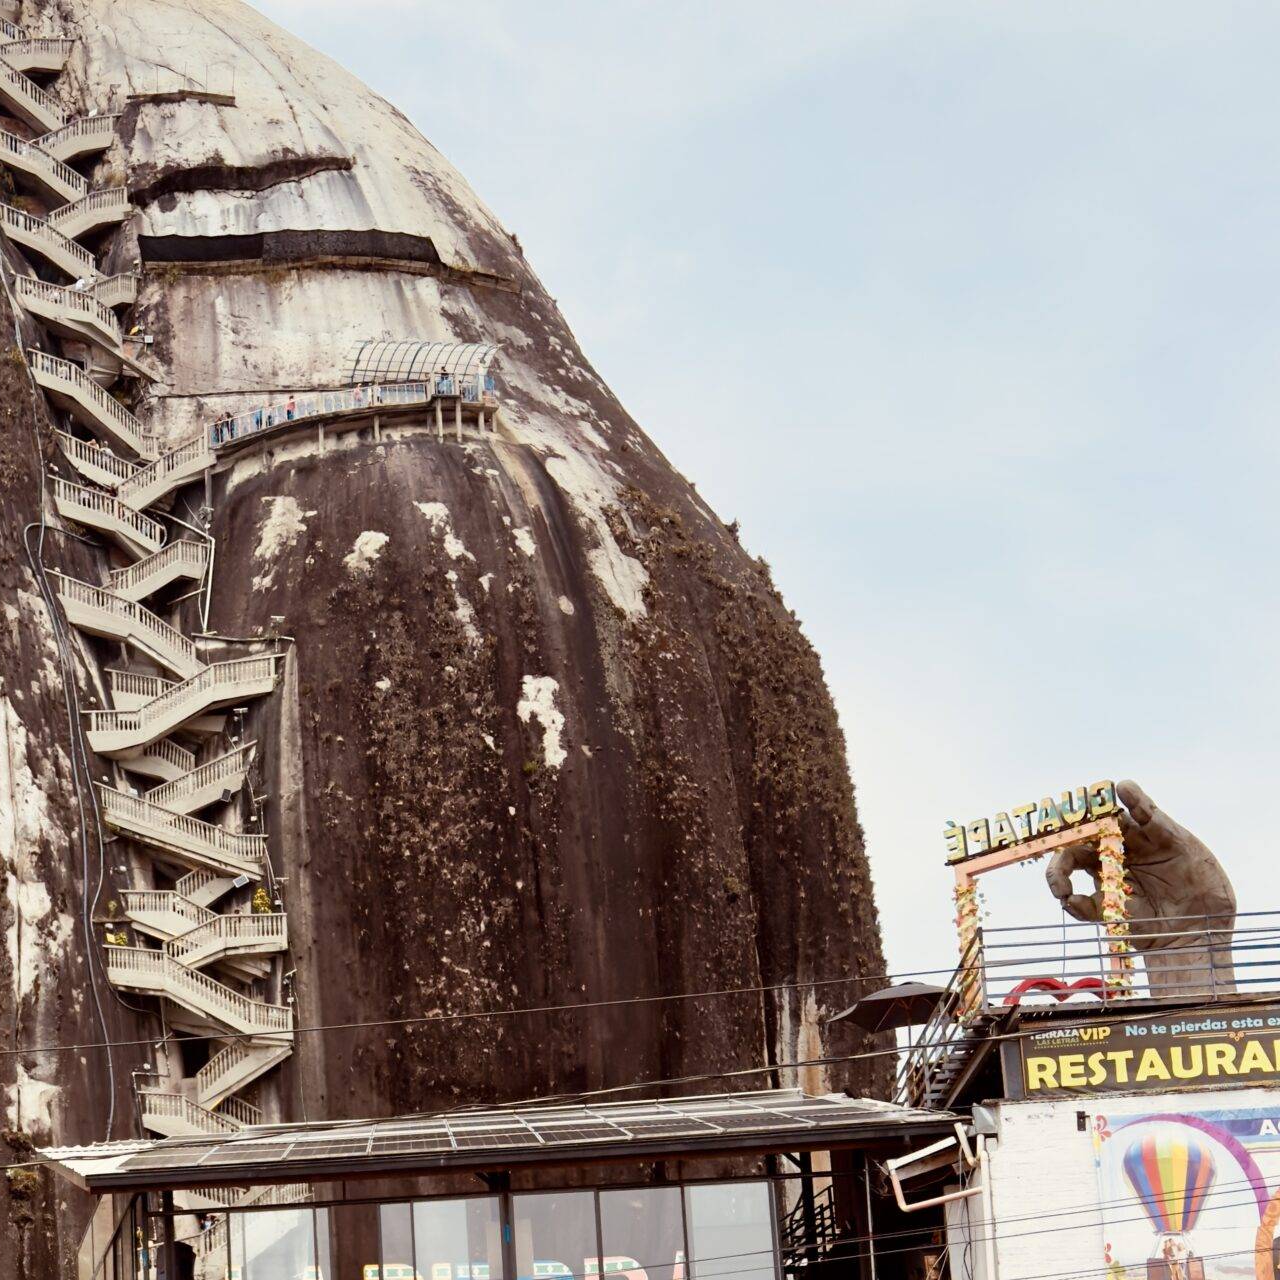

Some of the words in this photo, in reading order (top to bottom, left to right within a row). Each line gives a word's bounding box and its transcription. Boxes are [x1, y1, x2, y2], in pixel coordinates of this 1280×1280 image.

[1079, 1026, 1111, 1042] VIP
[1125, 1024, 1148, 1037] No
[1151, 1023, 1167, 1035] te
[1171, 1019, 1228, 1038] pierdas
[1232, 1018, 1264, 1029] esta
[1259, 1119, 1280, 1136] A
